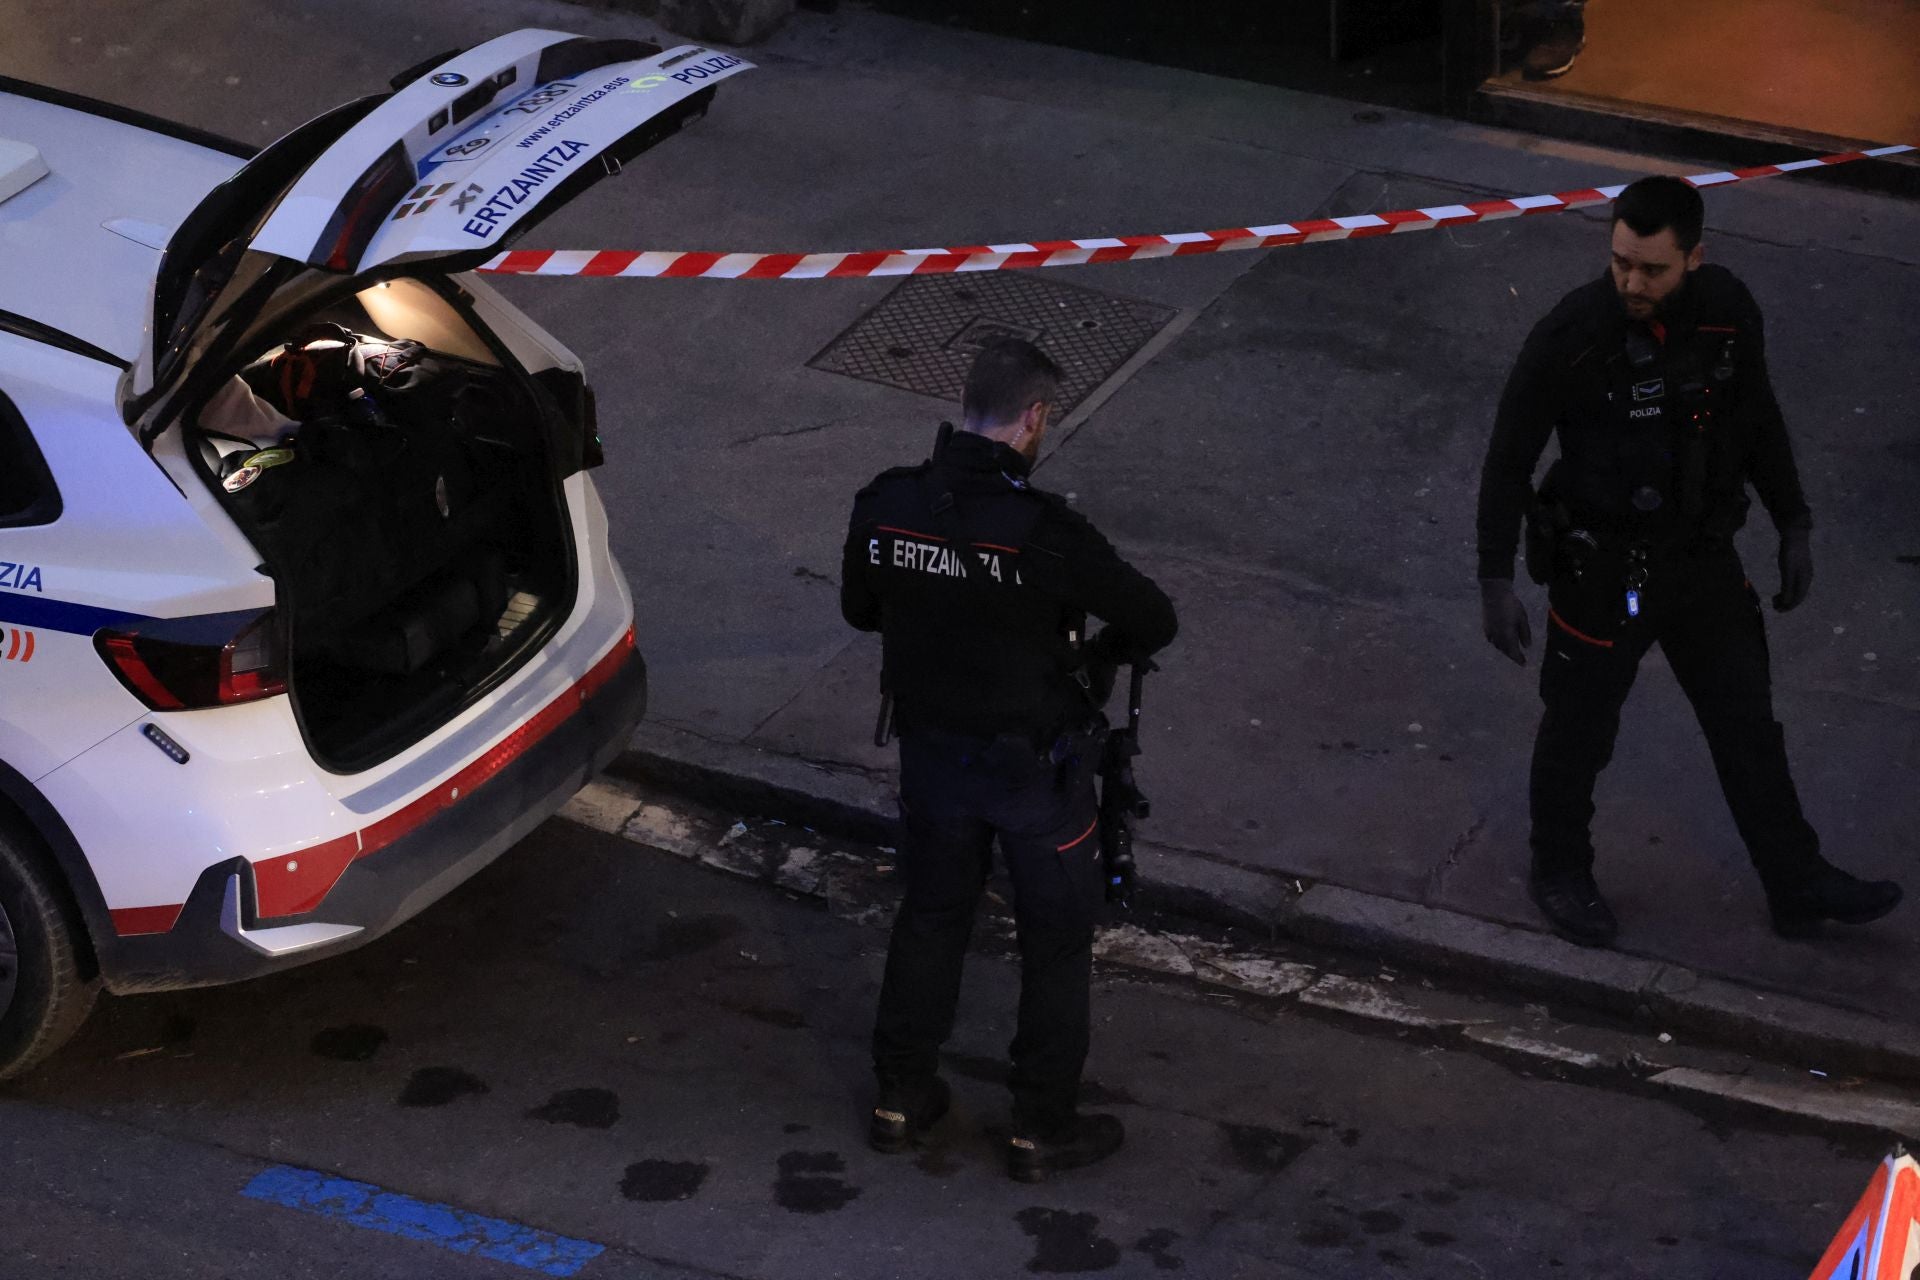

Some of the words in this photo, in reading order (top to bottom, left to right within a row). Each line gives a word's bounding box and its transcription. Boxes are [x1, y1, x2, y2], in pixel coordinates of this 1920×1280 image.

[670, 54, 744, 85] POLIZIA
[504, 82, 577, 115] 2887
[516, 76, 630, 148] www.ertzaintza.eus
[450, 183, 484, 214] X1
[463, 140, 589, 238] ERTZAINTZA
[1629, 406, 1662, 419] POLIZIA
